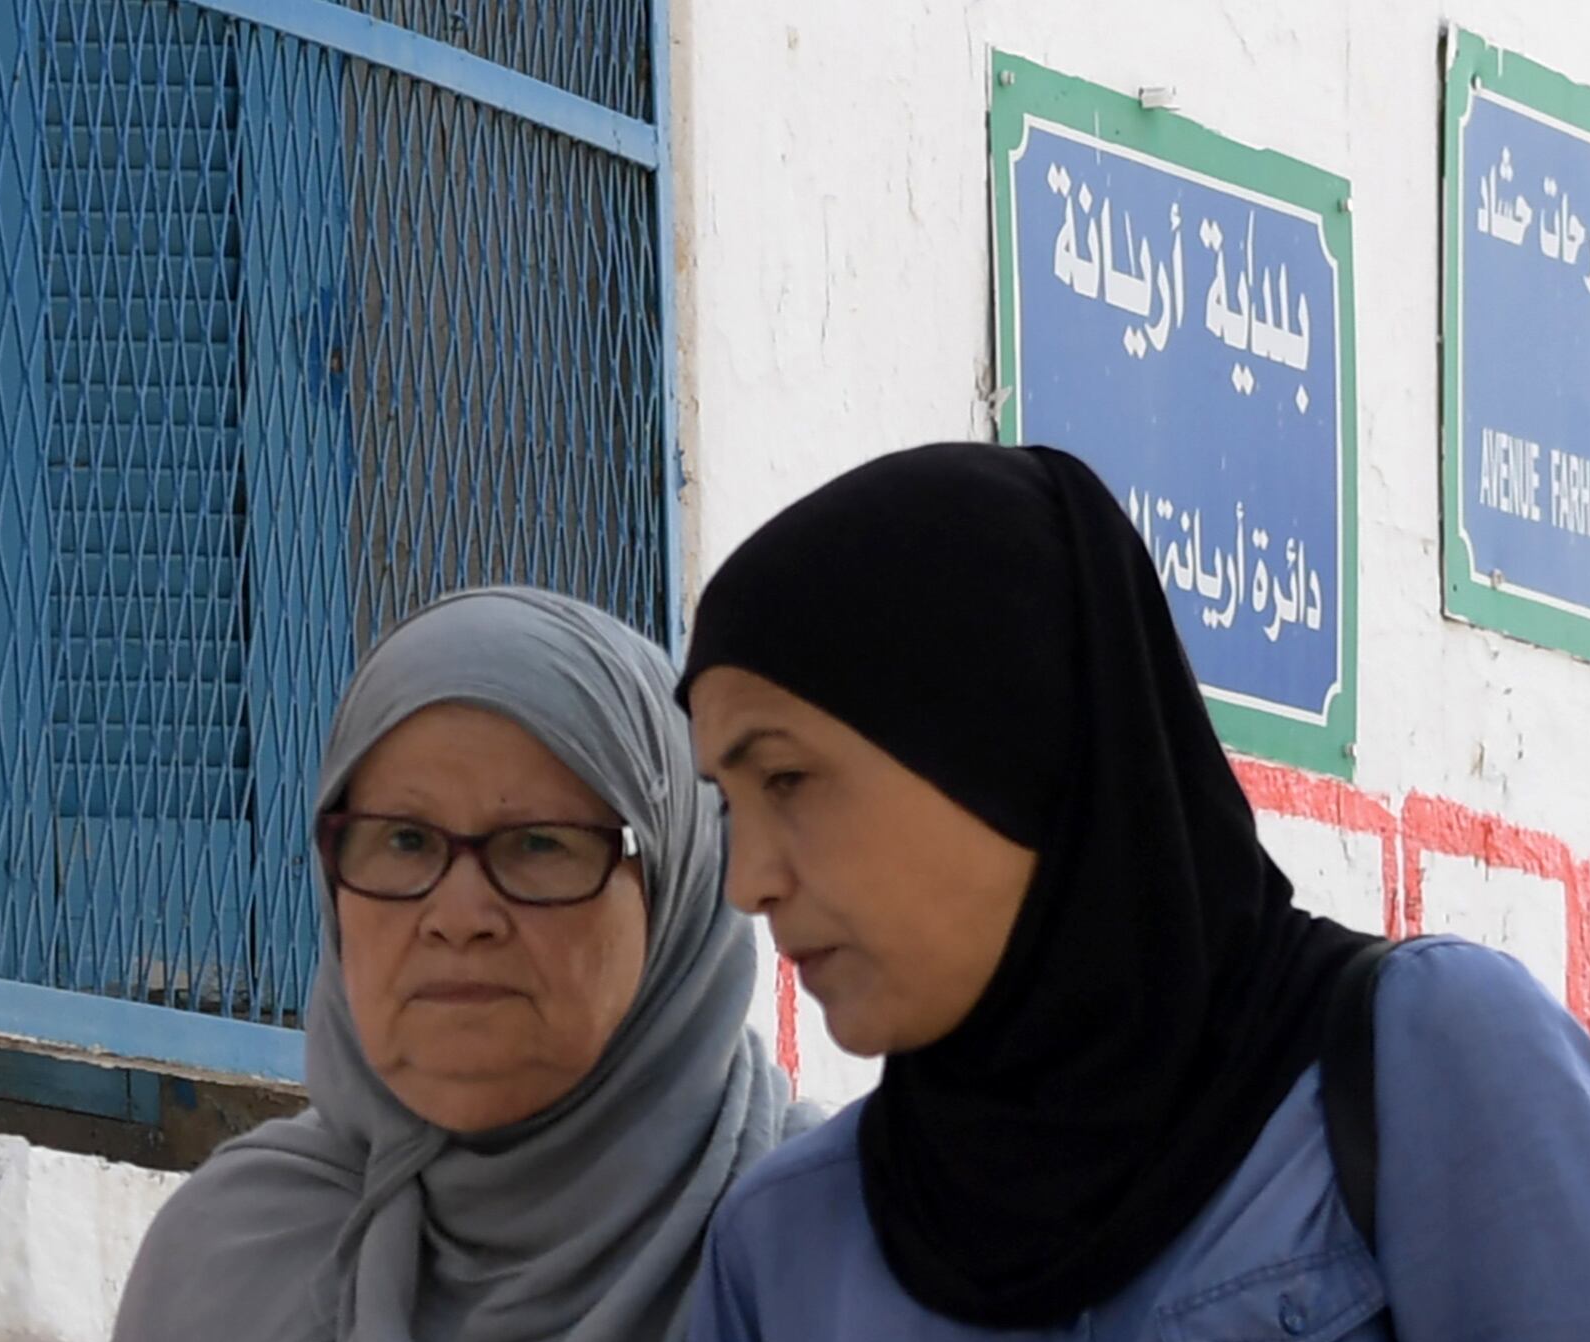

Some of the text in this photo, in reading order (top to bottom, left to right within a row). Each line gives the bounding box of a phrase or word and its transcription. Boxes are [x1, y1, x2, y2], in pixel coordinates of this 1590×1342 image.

[1478, 146, 1534, 246] حشاد
[1046, 161, 1309, 416] بلدية أريانة
[1480, 427, 1541, 522] AVENUE
[1252, 528, 1322, 643] دائرة
